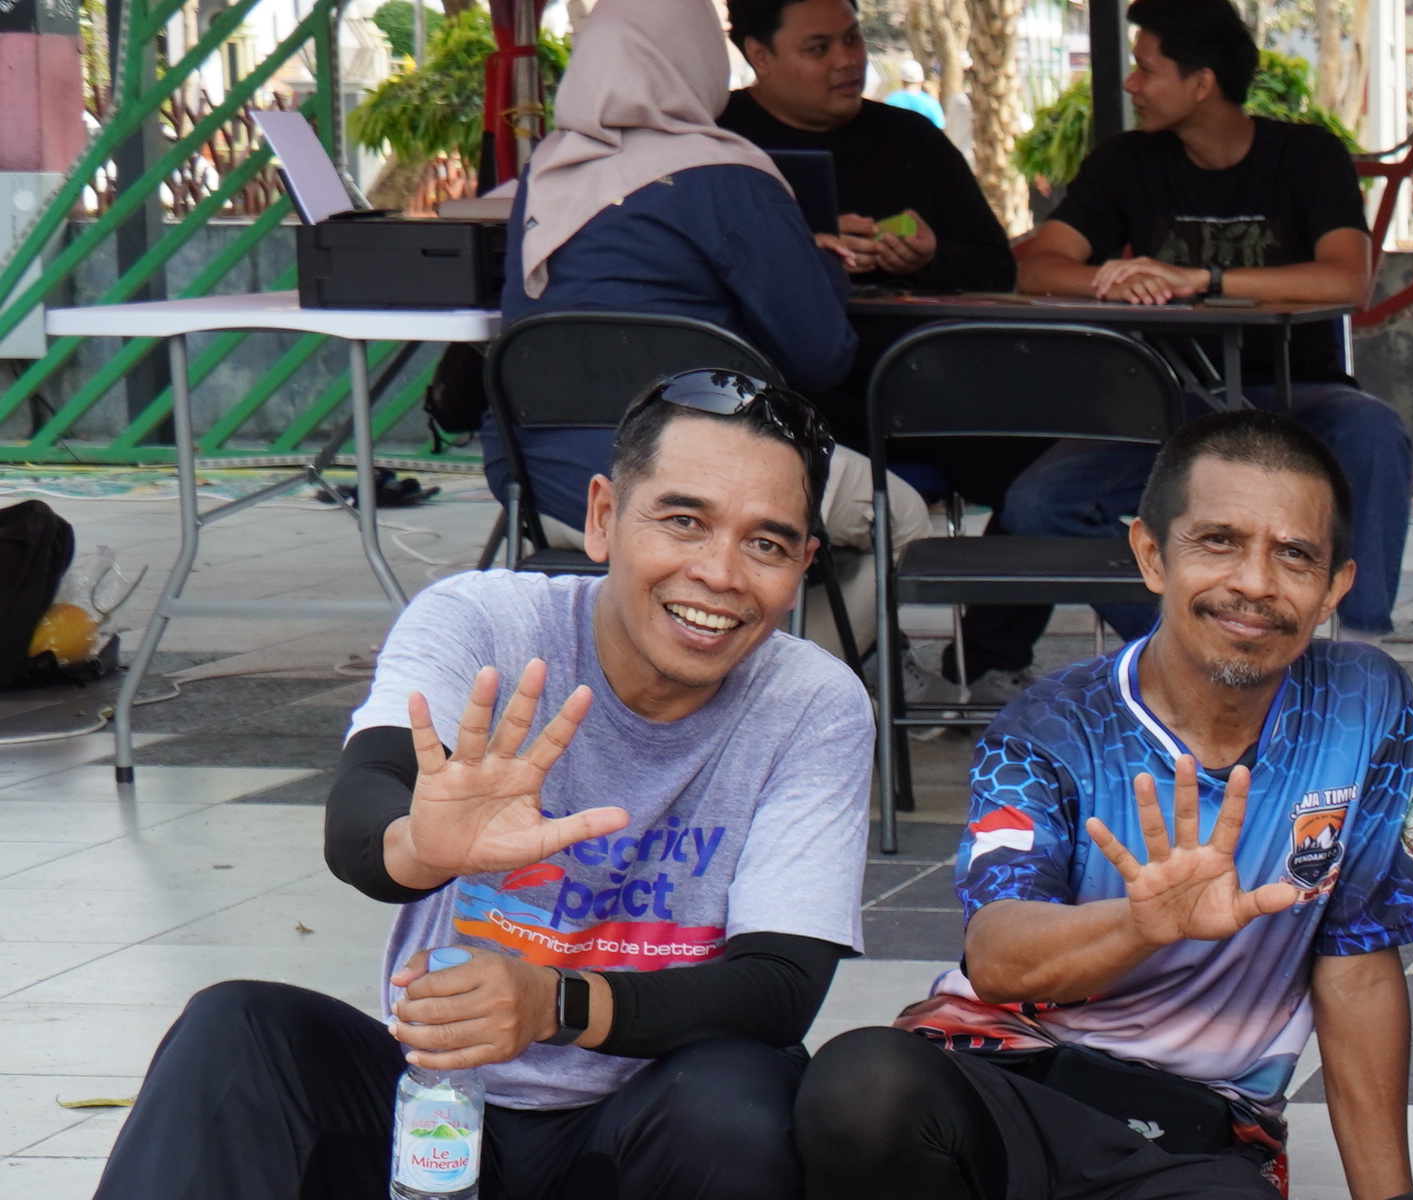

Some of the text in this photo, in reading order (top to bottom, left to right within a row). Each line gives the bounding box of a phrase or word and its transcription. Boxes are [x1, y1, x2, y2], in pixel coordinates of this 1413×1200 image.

[489, 908, 593, 955] Committed
[643, 941, 716, 958] better
[432, 1148, 450, 1160] Le
[411, 1155, 470, 1169] Minerale
